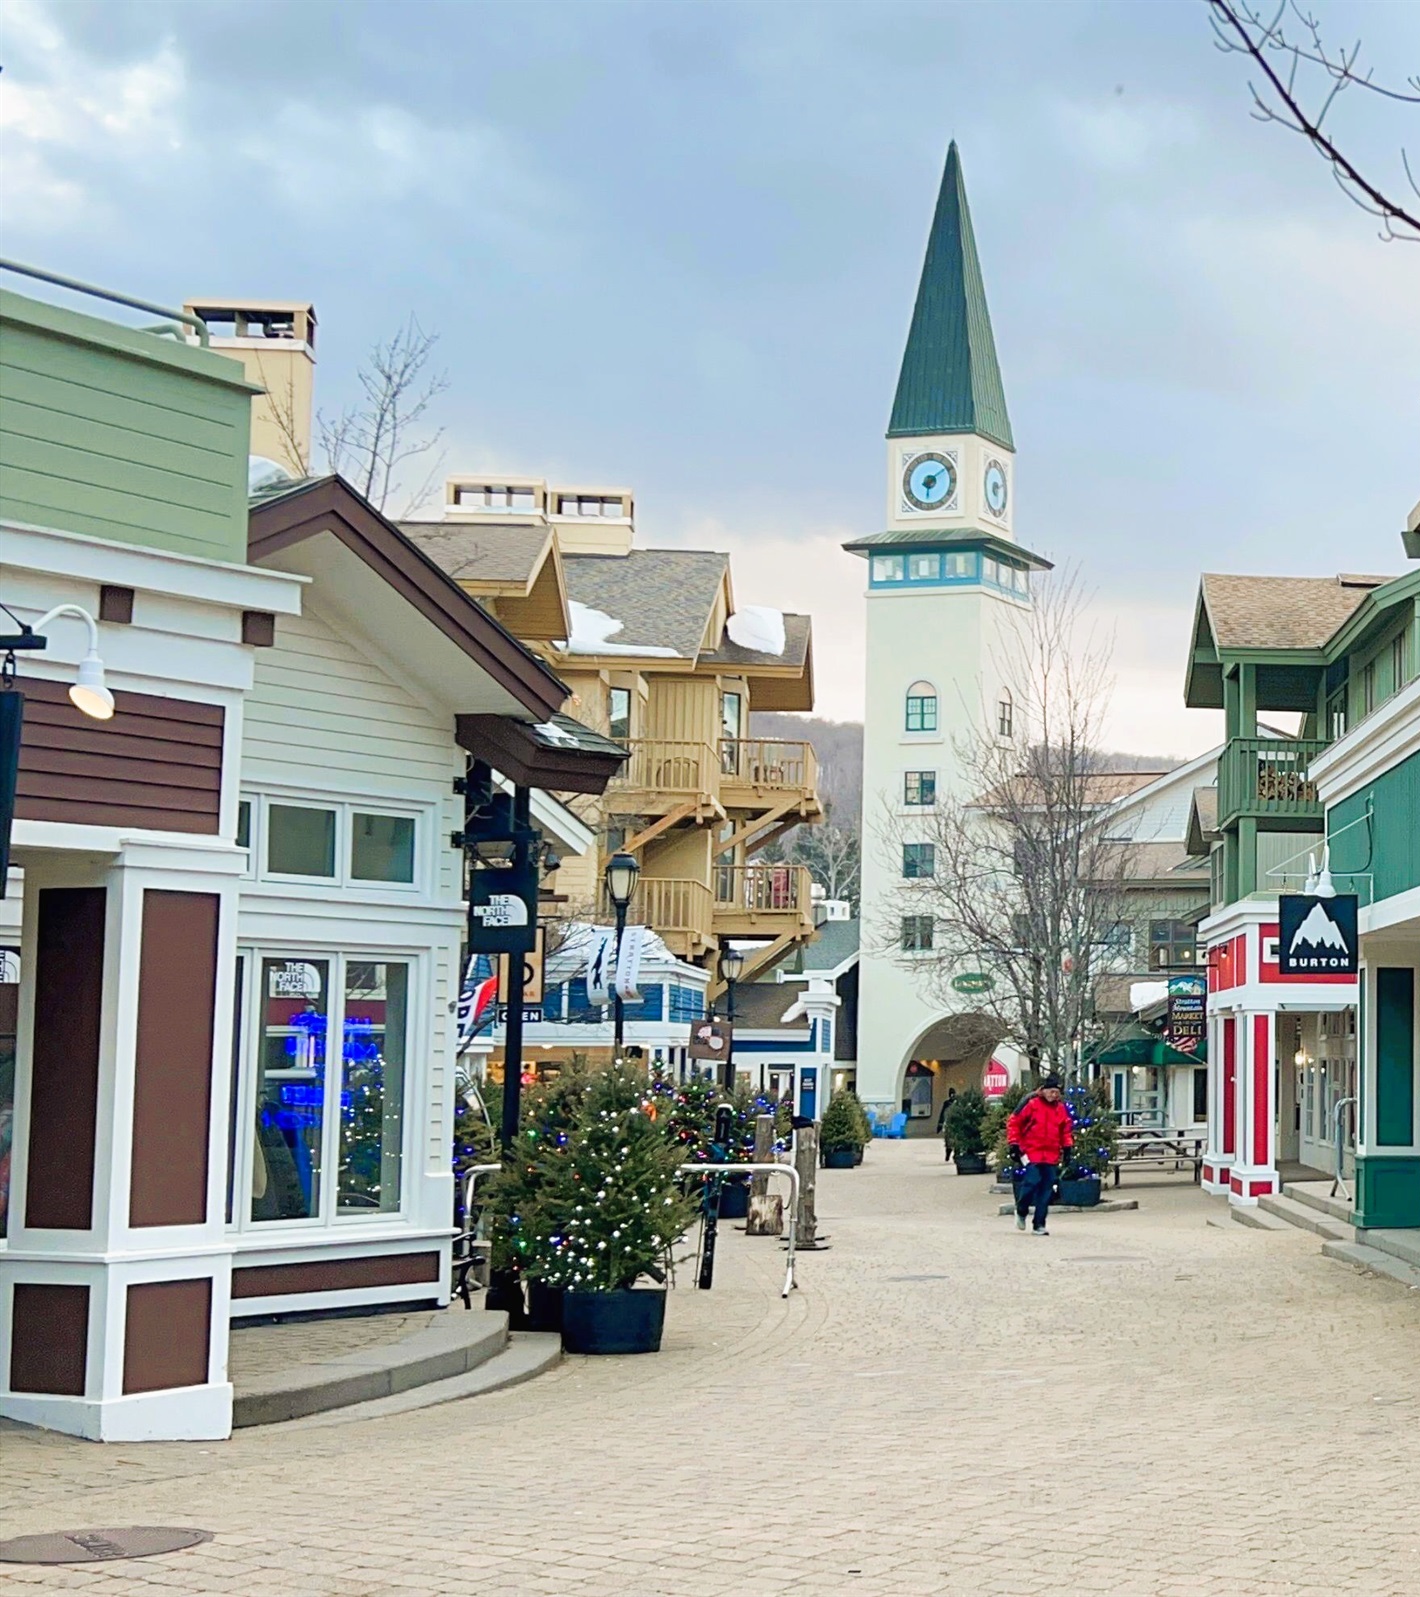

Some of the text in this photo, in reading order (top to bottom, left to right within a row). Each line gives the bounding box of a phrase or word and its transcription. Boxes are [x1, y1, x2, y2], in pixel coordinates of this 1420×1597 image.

[488, 895, 509, 906] THE
[473, 906, 508, 917] NORTH
[483, 916, 509, 927] FACE
[284, 962, 305, 972] THE
[1289, 958, 1349, 967] BURTON
[270, 971, 304, 982] NORTH
[280, 981, 305, 992] FACE
[1171, 1012, 1204, 1020] MARKET
[1173, 1025, 1202, 1036] DELI
